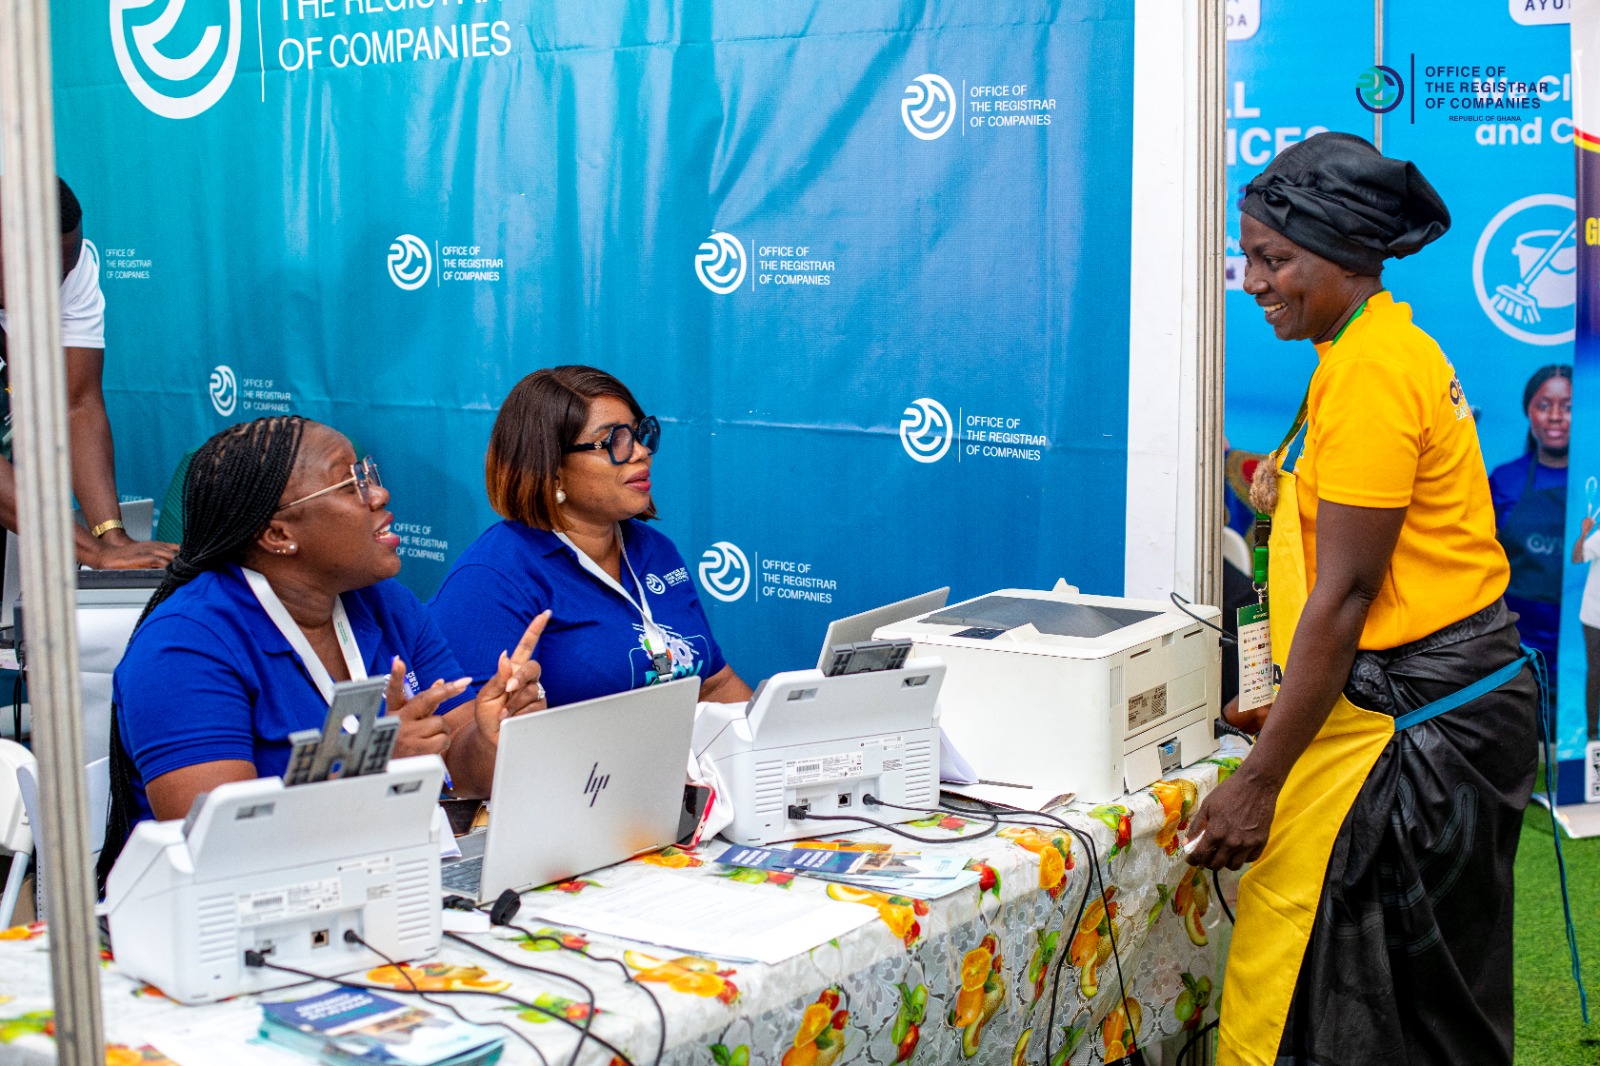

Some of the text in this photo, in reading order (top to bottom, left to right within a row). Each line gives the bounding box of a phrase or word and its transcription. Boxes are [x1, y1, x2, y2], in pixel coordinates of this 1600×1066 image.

[278, 21, 512, 71] OF COMPANIES
[970, 85, 1027, 97] OFFICE OF
[970, 99, 1056, 112] THE REGISTRAR
[970, 115, 1051, 127] OF COMPANIES
[1475, 116, 1542, 145] and
[105, 248, 135, 257] OFFICE OF
[442, 246, 480, 255] OFFICE OF
[759, 246, 810, 256] OFFICE OF
[106, 259, 152, 268] THE REGISTRAR
[443, 259, 503, 268] THE REGISTRAR
[759, 261, 835, 271] THE REGISTRAR
[443, 271, 500, 281] OF COMPANIES
[759, 274, 830, 285] OF COMPANIES
[966, 416, 1020, 429] OFFICE OF
[966, 430, 1046, 446] THE REGISTRAR
[966, 444, 1040, 460] OF COMPANIES
[394, 523, 431, 535] OFFICE OF
[412, 537, 448, 549] REGISTRAR
[395, 547, 445, 562] OF COMPANIES
[762, 559, 811, 573] OFFICE OF
[762, 572, 836, 590] THE REGISTRAR
[762, 586, 832, 603] OF COMPANIES
